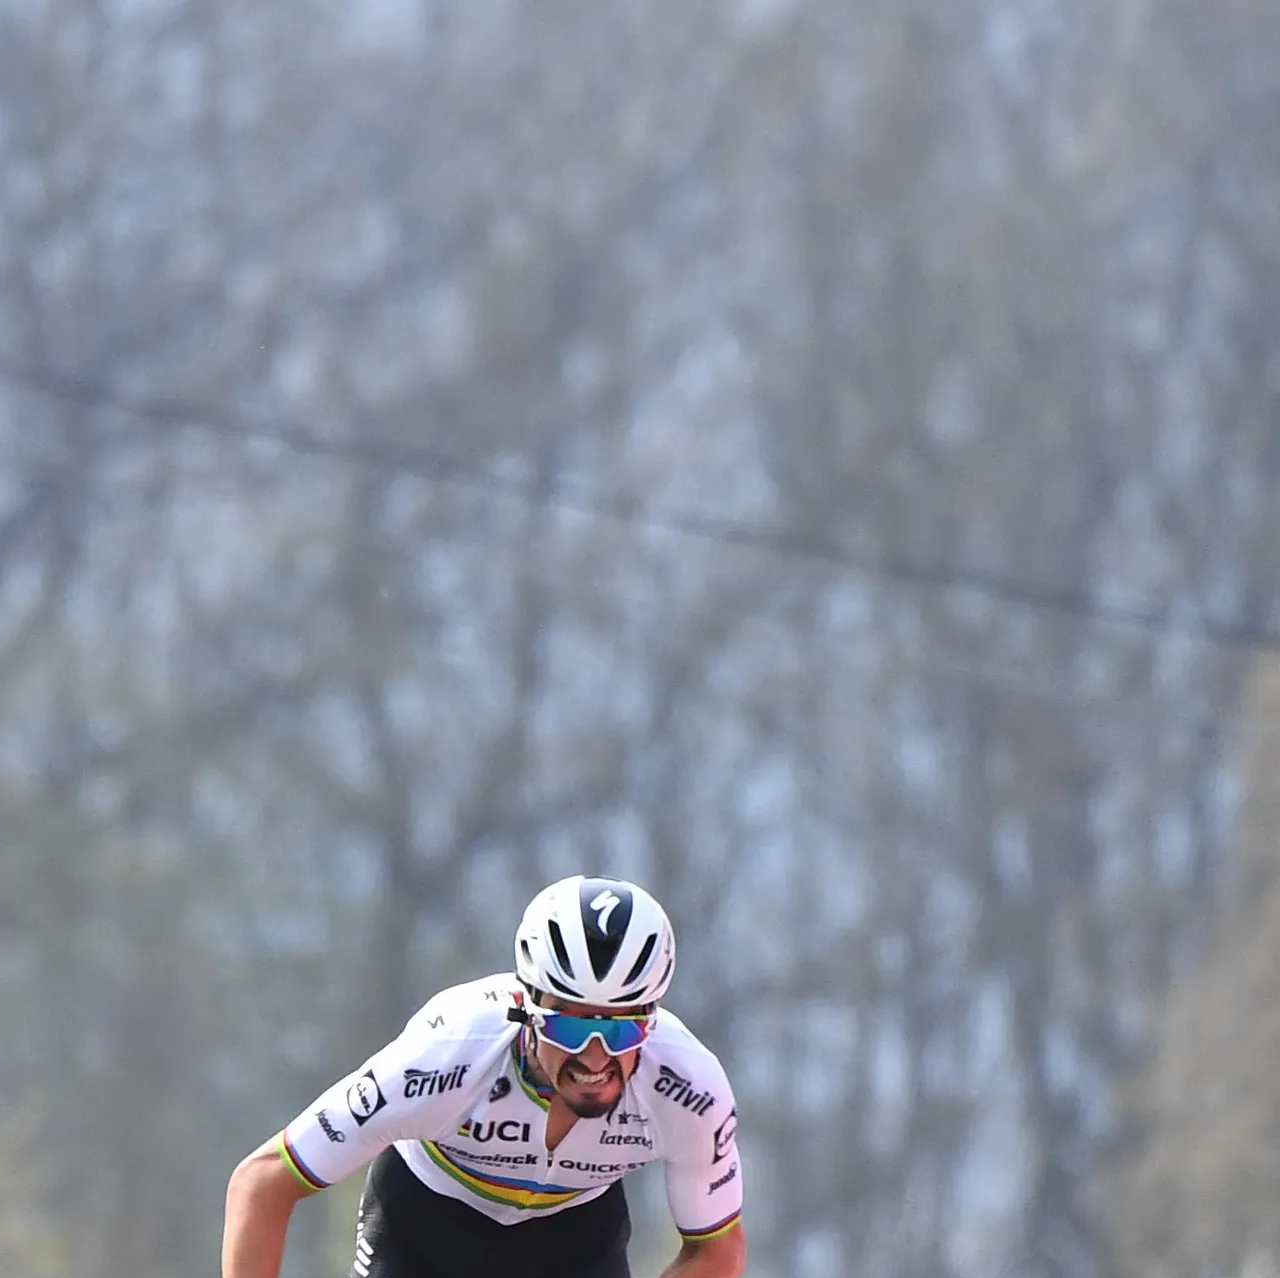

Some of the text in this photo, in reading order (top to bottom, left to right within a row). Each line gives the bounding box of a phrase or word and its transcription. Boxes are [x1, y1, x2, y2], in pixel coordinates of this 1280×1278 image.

[404, 1064, 472, 1099] crivit
[653, 1077, 717, 1117] crivit
[473, 1120, 531, 1143] UCI
[559, 1159, 647, 1173] QUICK-ST
